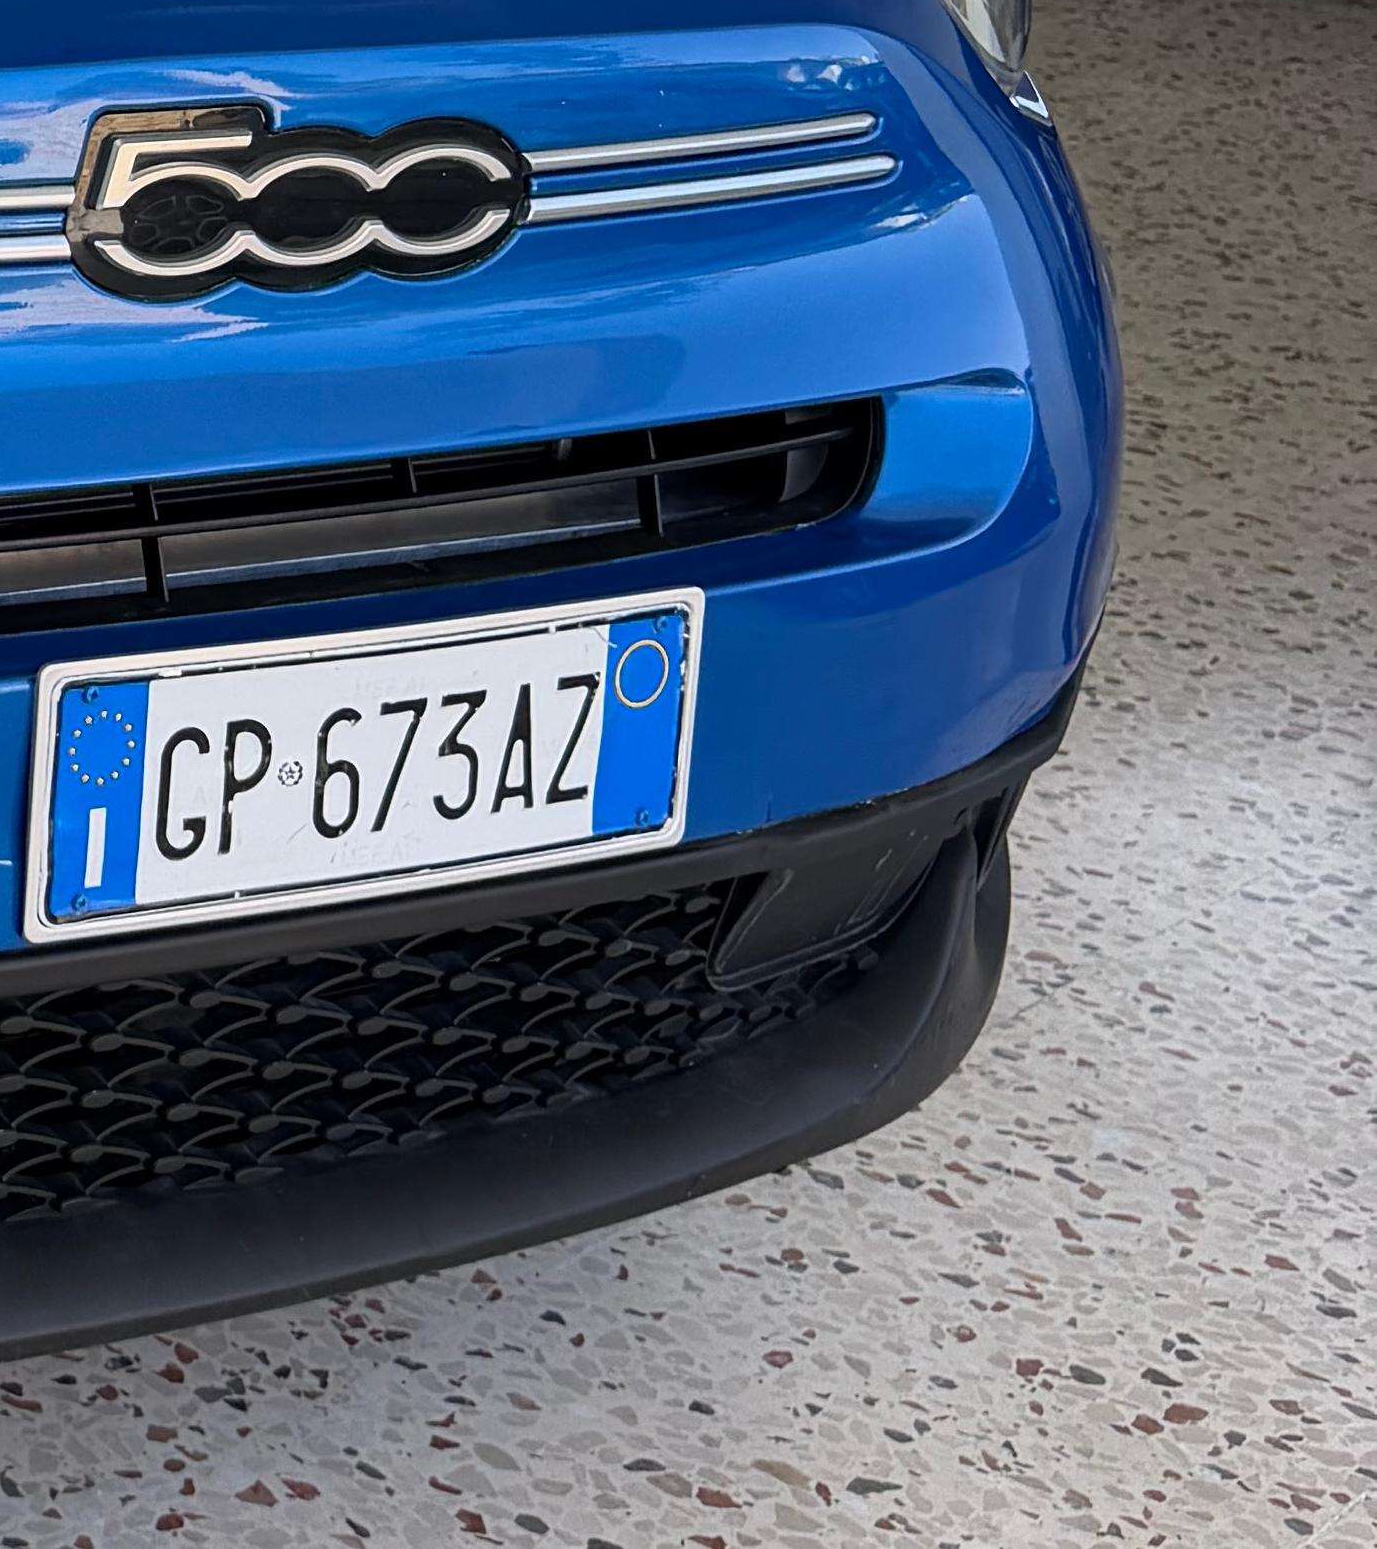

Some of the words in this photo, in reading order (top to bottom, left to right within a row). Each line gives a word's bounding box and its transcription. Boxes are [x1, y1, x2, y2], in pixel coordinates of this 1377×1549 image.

[91, 127, 513, 278] 500
[155, 718, 272, 862] GP
[312, 671, 602, 840] 673AZ
[83, 806, 108, 889] I
